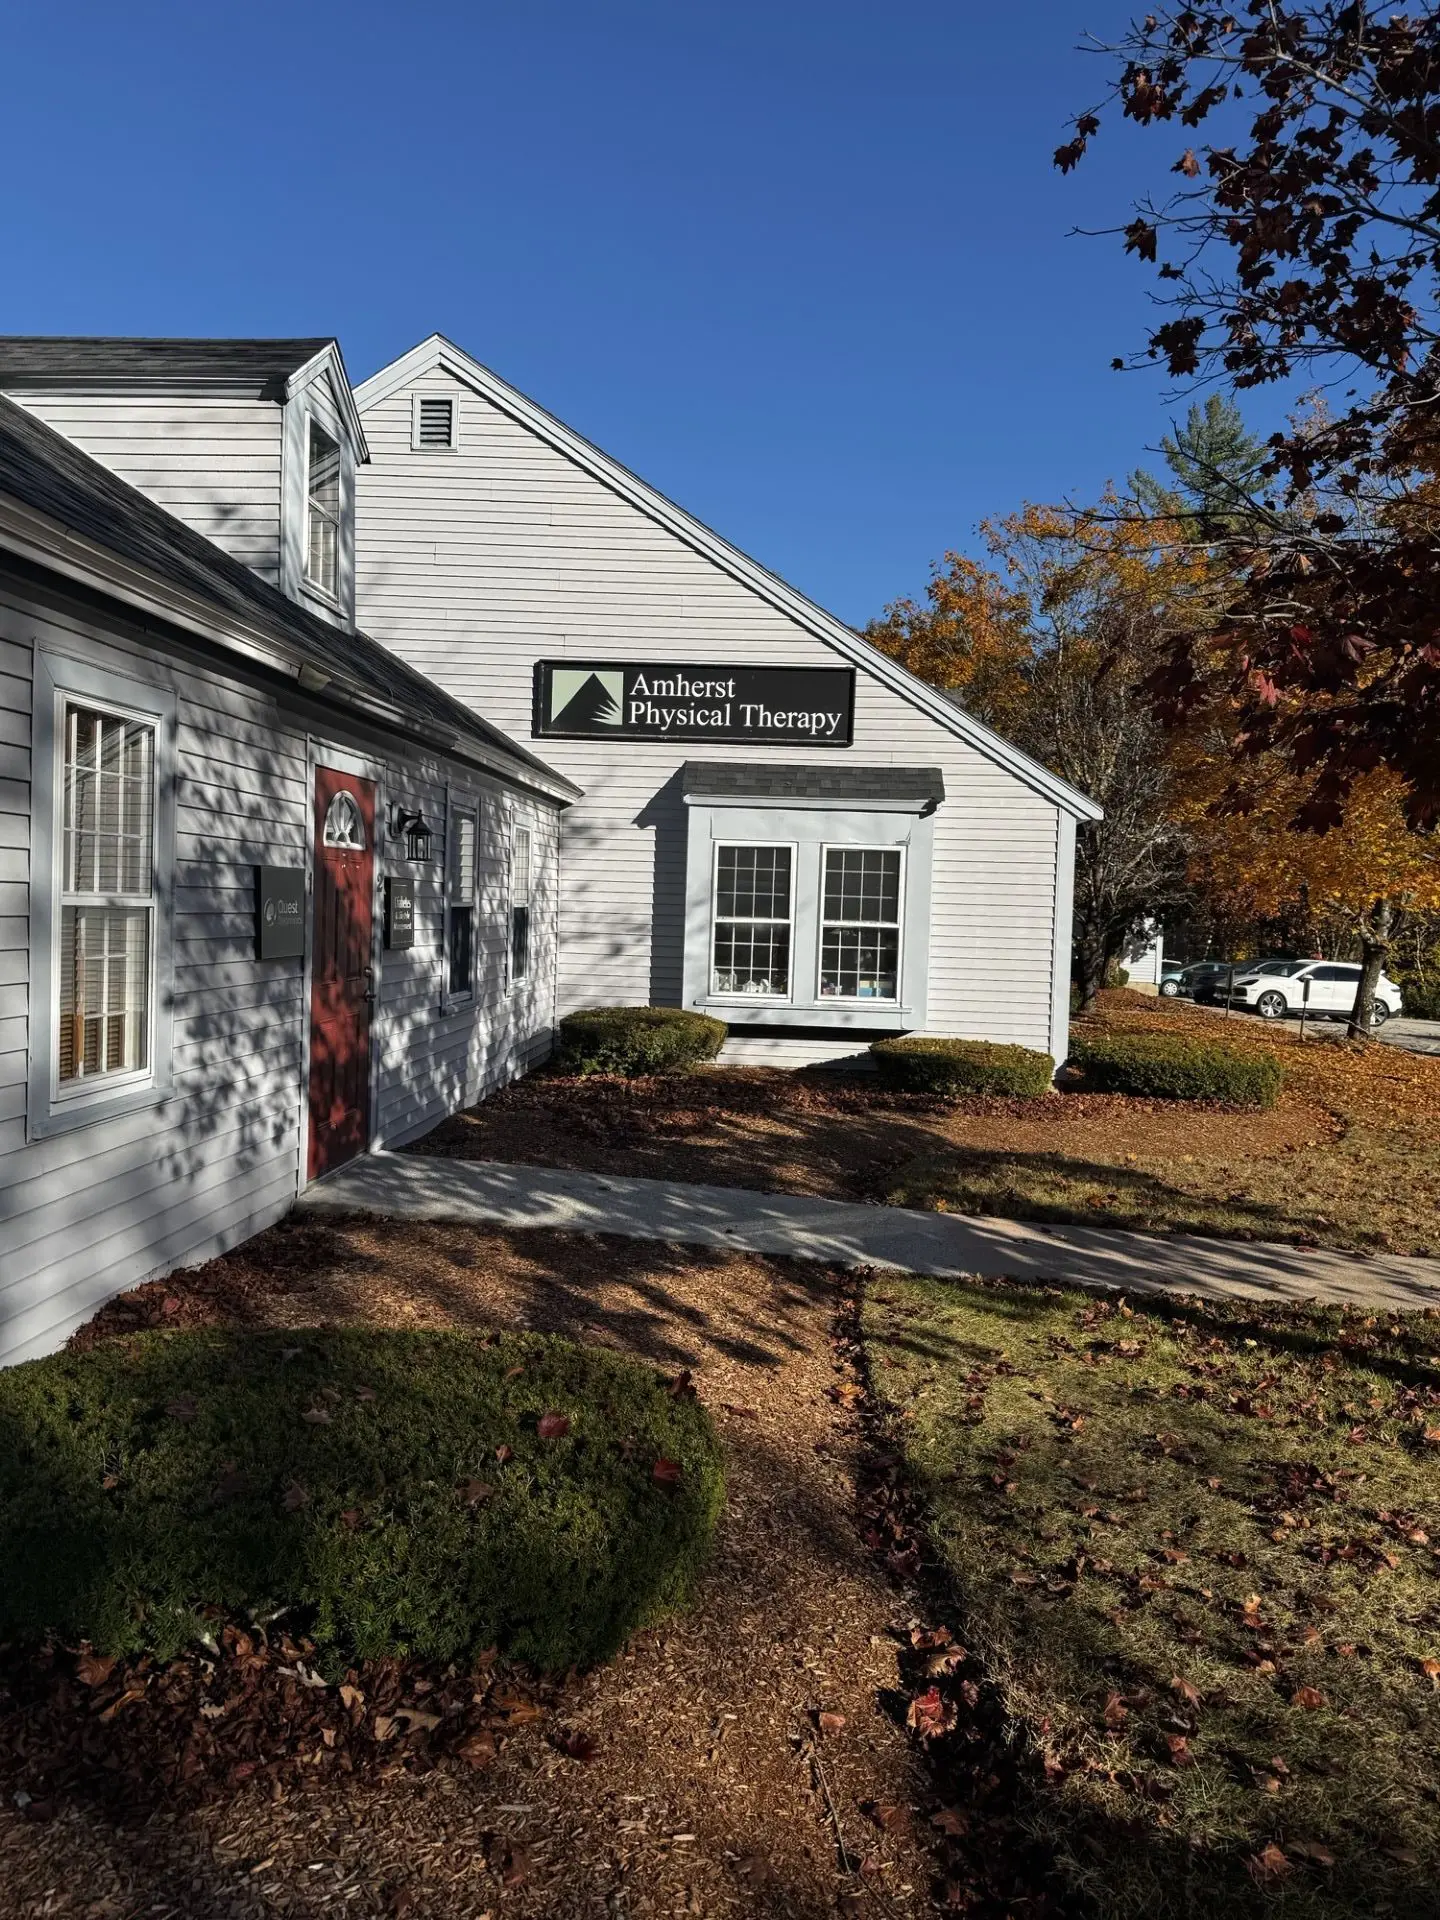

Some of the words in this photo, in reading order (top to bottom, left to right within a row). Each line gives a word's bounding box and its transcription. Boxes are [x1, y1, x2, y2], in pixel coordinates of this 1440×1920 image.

[630, 673, 736, 698] Amherst
[629, 701, 731, 730] Physical
[741, 704, 841, 735] Therapy
[376, 873, 384, 892] 2
[278, 899, 298, 913] Quest
